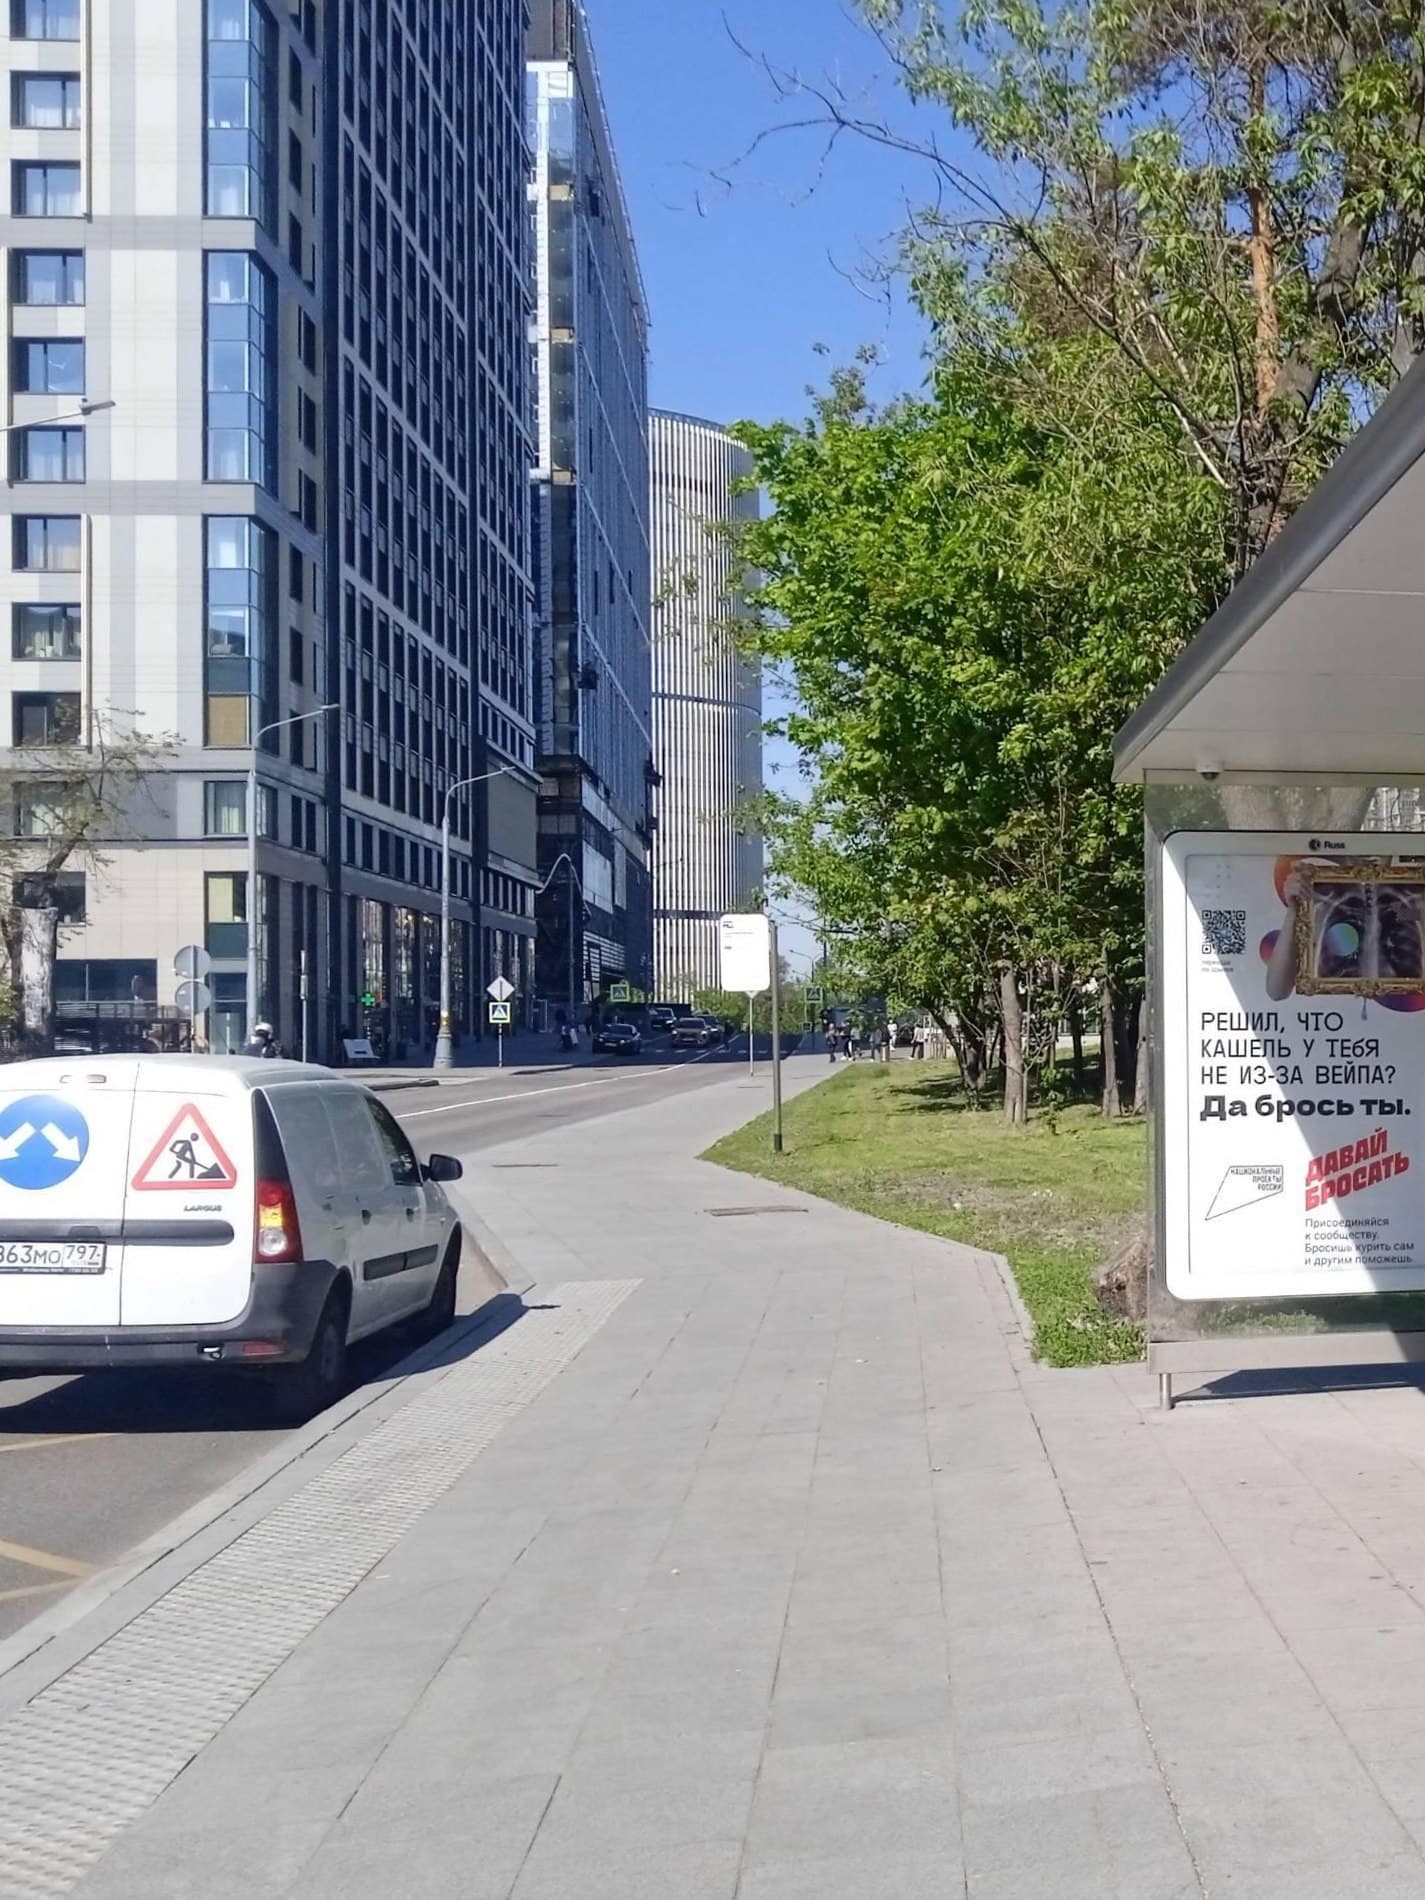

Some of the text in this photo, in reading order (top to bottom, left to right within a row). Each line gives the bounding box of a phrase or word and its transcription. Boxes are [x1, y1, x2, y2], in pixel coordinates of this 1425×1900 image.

[1324, 840, 1346, 850] Russ
[1201, 1012, 1344, 1033] РЕШИЛ, ЧТО
[1201, 1039, 1292, 1058] КАШЕЛЬ
[1303, 1039, 1315, 1058] У
[1201, 1061, 1396, 1085] НЕ ИЗ-ЗА ВЕЙПА?
[1200, 1094, 1412, 1122] Да брось ты.
[1305, 1127, 1388, 1187] ДАВАЙ
[1305, 1152, 1410, 1212] БРОСАТЬ
[1305, 1217, 1389, 1229] Присоединяйся
[65, 1245, 98, 1260] 797
[1305, 1242, 1414, 1254] Бросишь курить сам
[1314, 1257, 1352, 1267] другим
